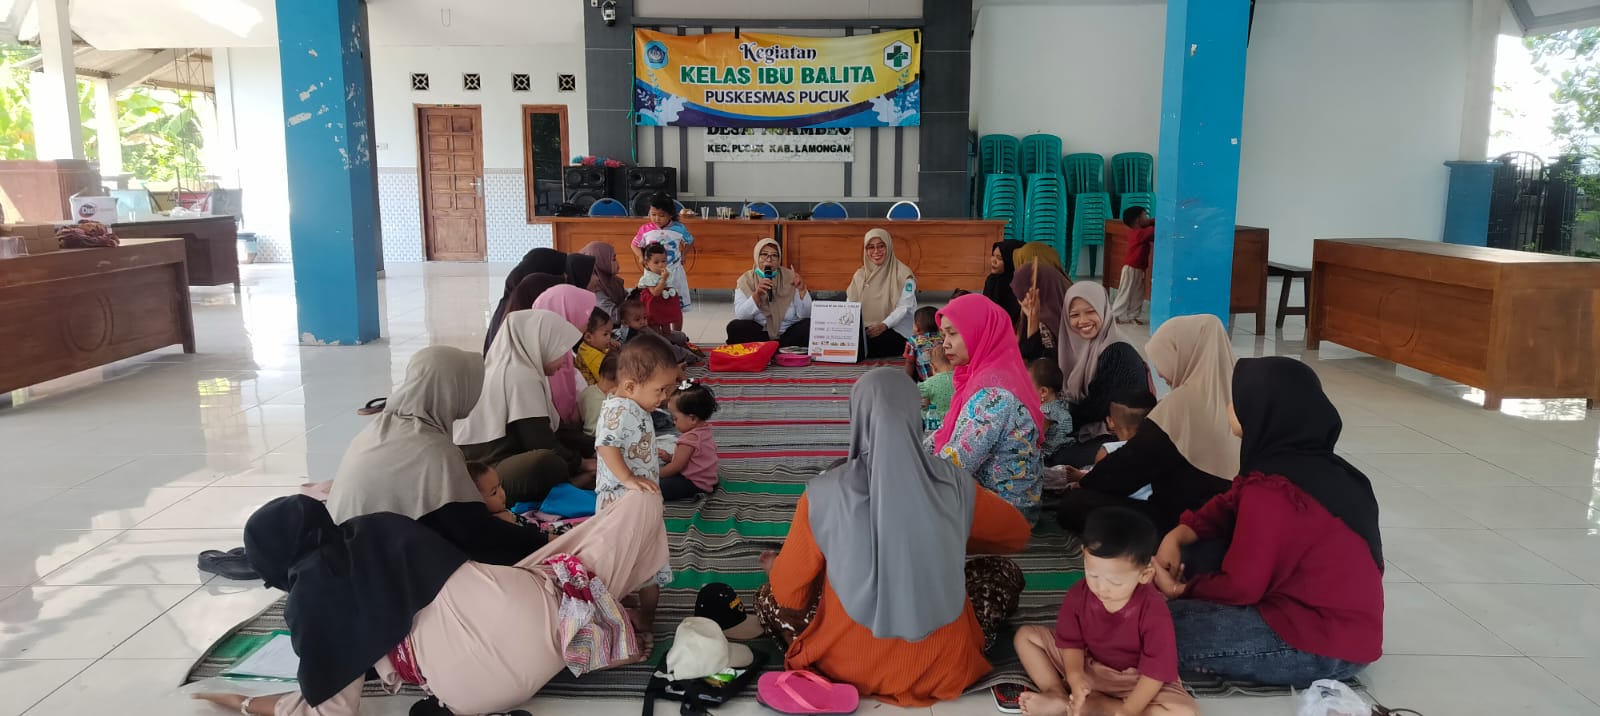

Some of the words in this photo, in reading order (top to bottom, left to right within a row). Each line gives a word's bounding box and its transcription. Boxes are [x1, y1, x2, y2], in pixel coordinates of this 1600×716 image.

[740, 41, 817, 64] Kegiatan
[680, 66, 752, 85] KELAS
[758, 66, 794, 84] IBU
[800, 65, 875, 84] BALITA
[705, 90, 795, 104] PUSKESMAS
[799, 89, 850, 103] PUCUK
[707, 144, 731, 153] KEC.
[769, 144, 794, 153] KAB.
[795, 144, 851, 153] LAMONGAN
